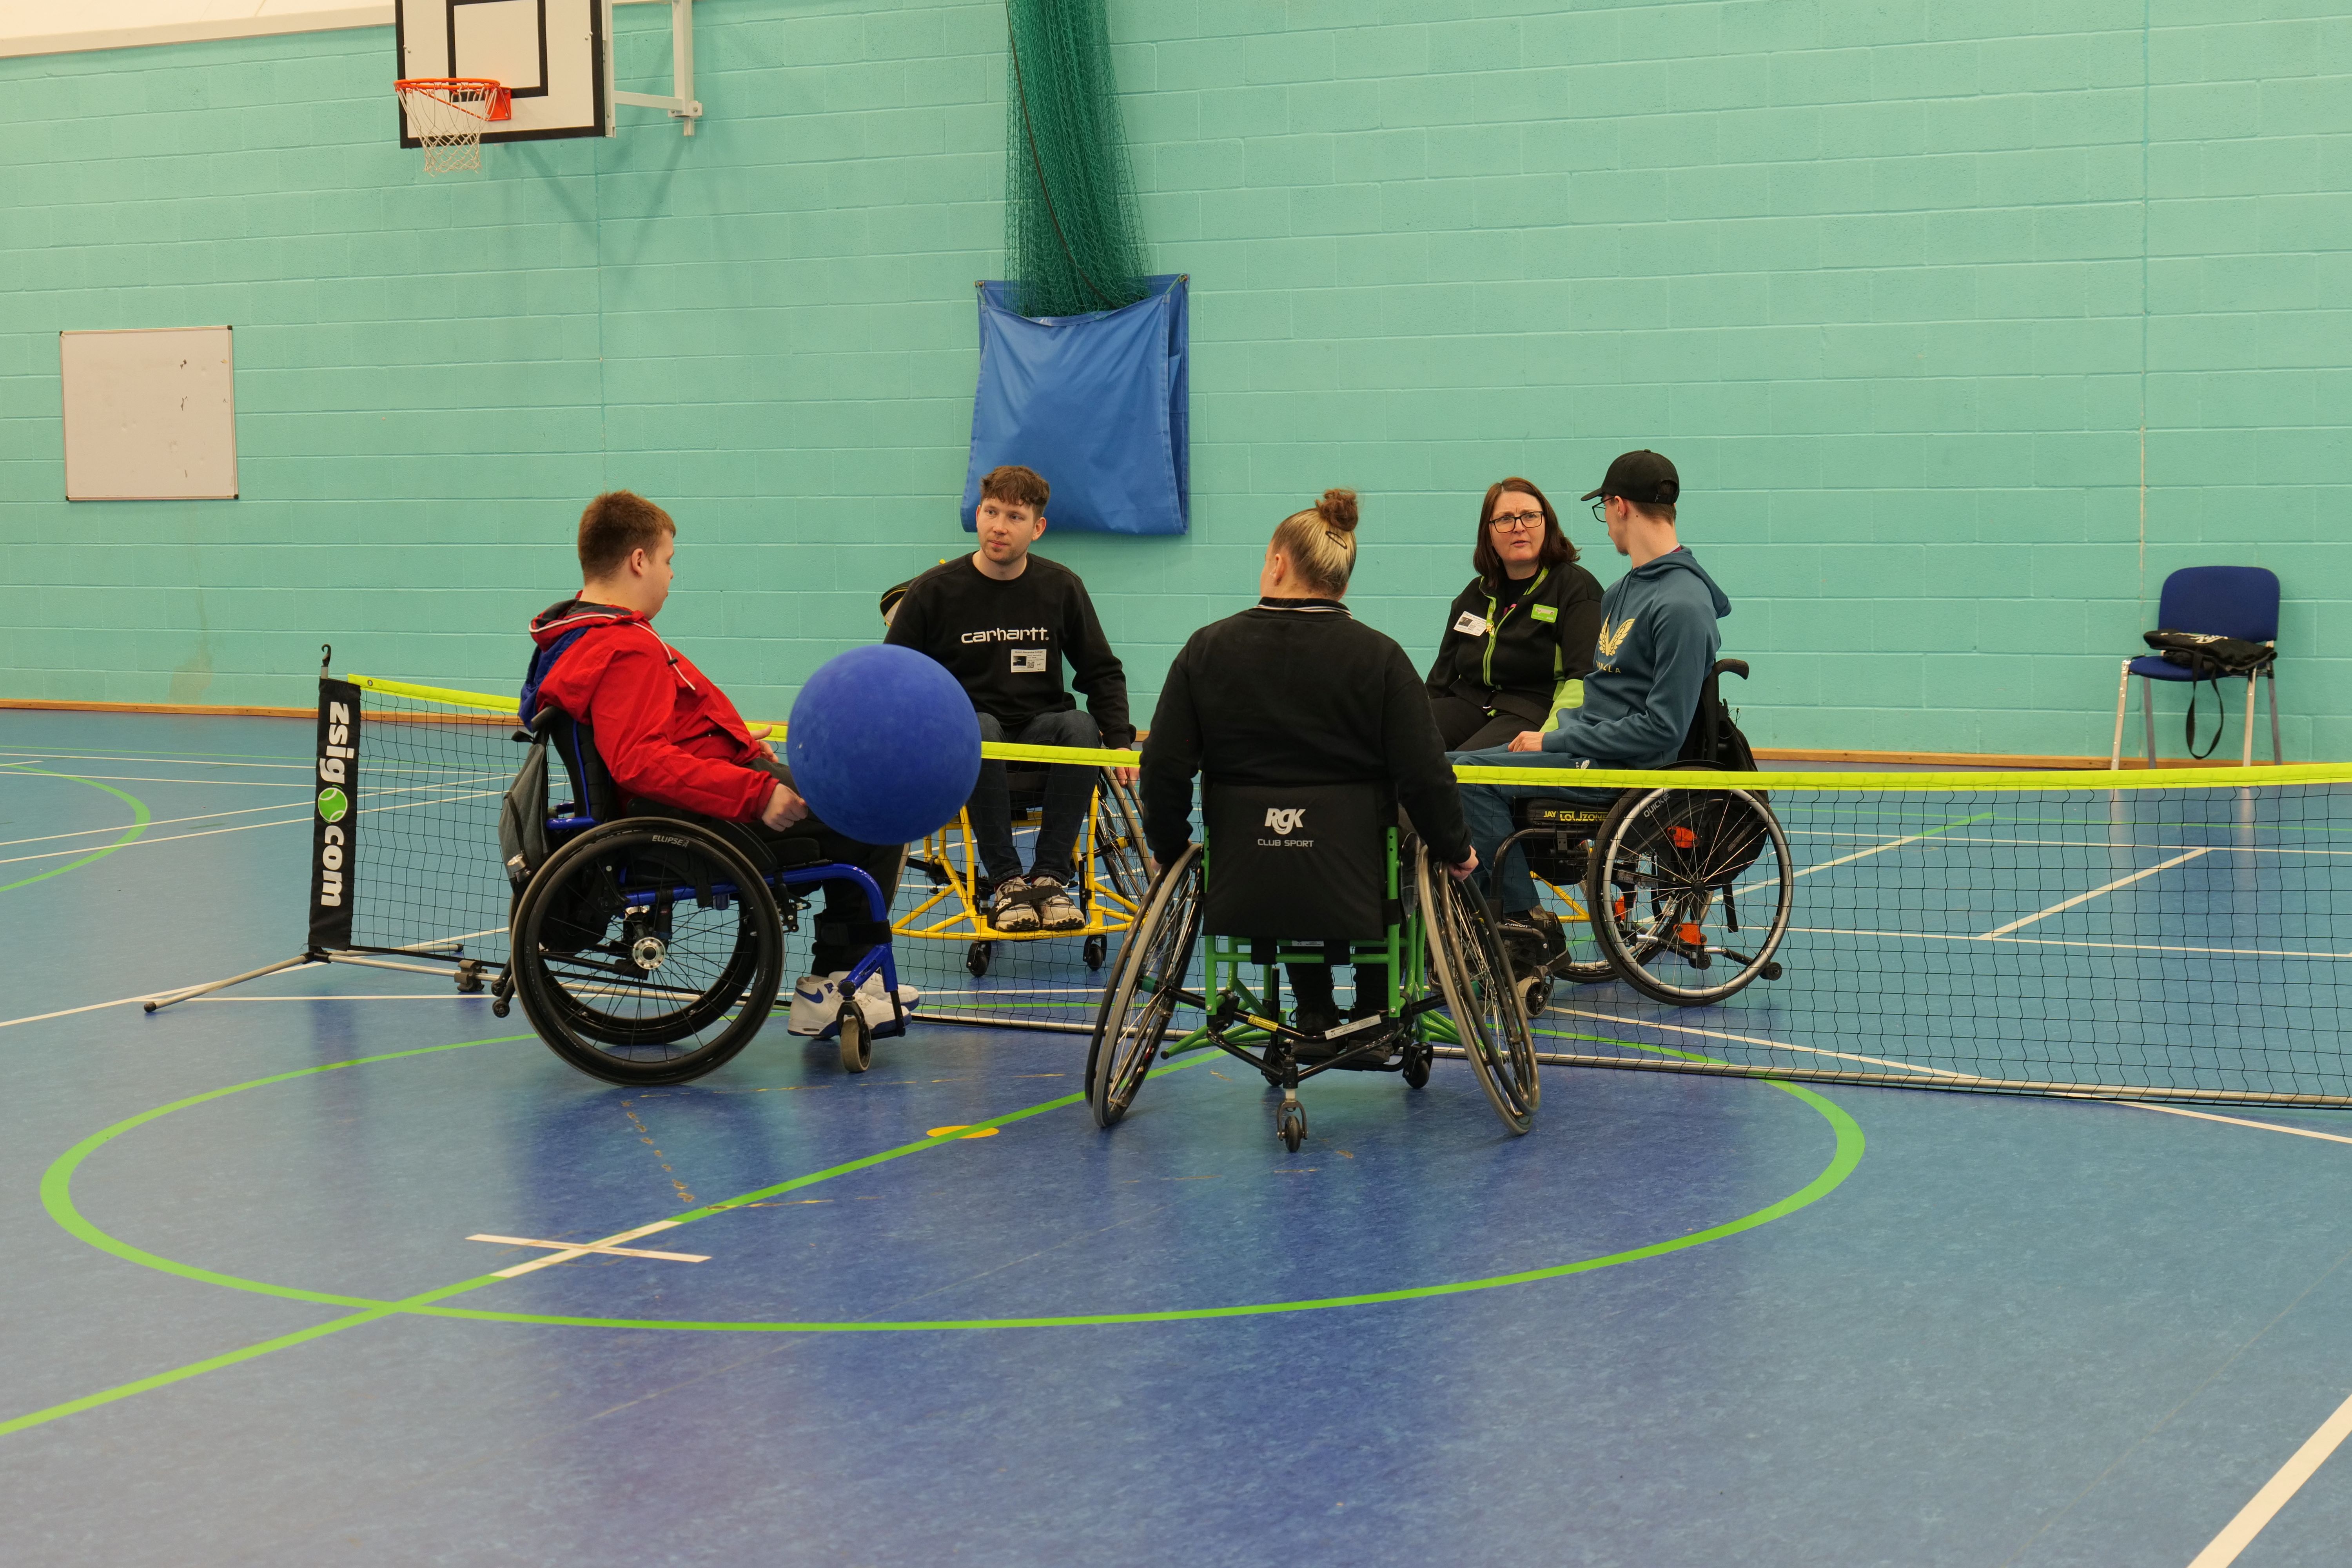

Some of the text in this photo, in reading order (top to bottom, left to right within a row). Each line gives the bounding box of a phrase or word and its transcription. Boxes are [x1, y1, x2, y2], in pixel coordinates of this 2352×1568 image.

[961, 627, 1048, 643] carhartt
[319, 701, 356, 907] zsig com
[1643, 793, 1671, 818] QUICKIE
[1264, 808, 1306, 835] RGK
[652, 835, 683, 846] ELLIPSE
